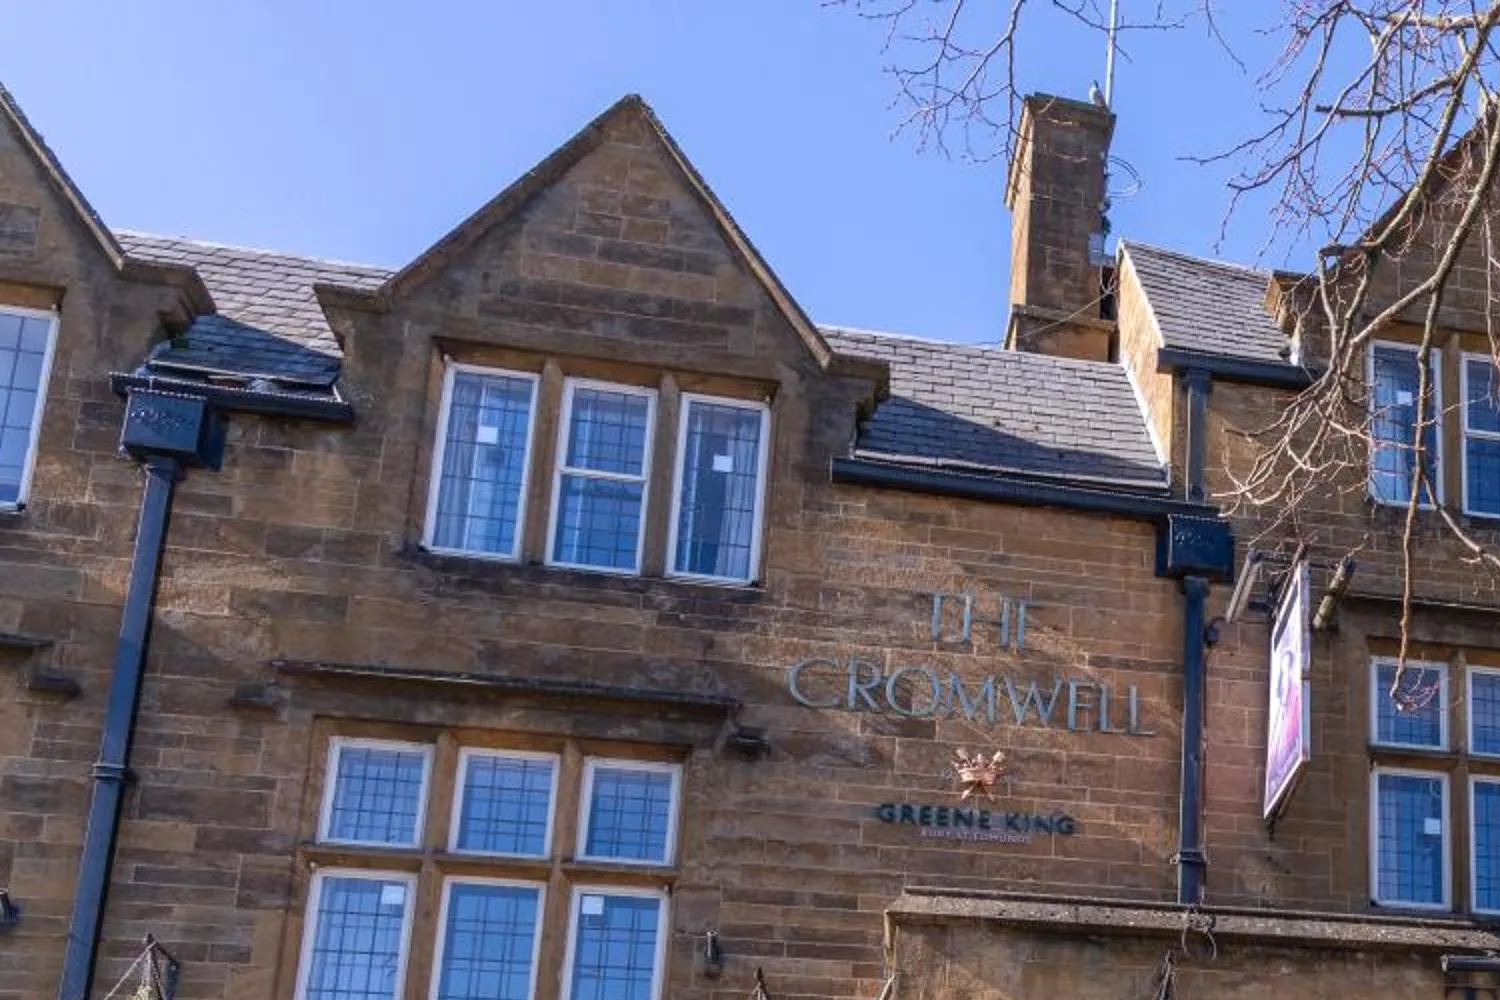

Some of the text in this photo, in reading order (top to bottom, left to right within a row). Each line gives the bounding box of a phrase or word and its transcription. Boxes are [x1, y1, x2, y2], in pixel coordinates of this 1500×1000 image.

[927, 592, 1034, 651] THE
[787, 656, 1156, 736] CROMWELL
[878, 803, 1076, 834] GREENE KING
